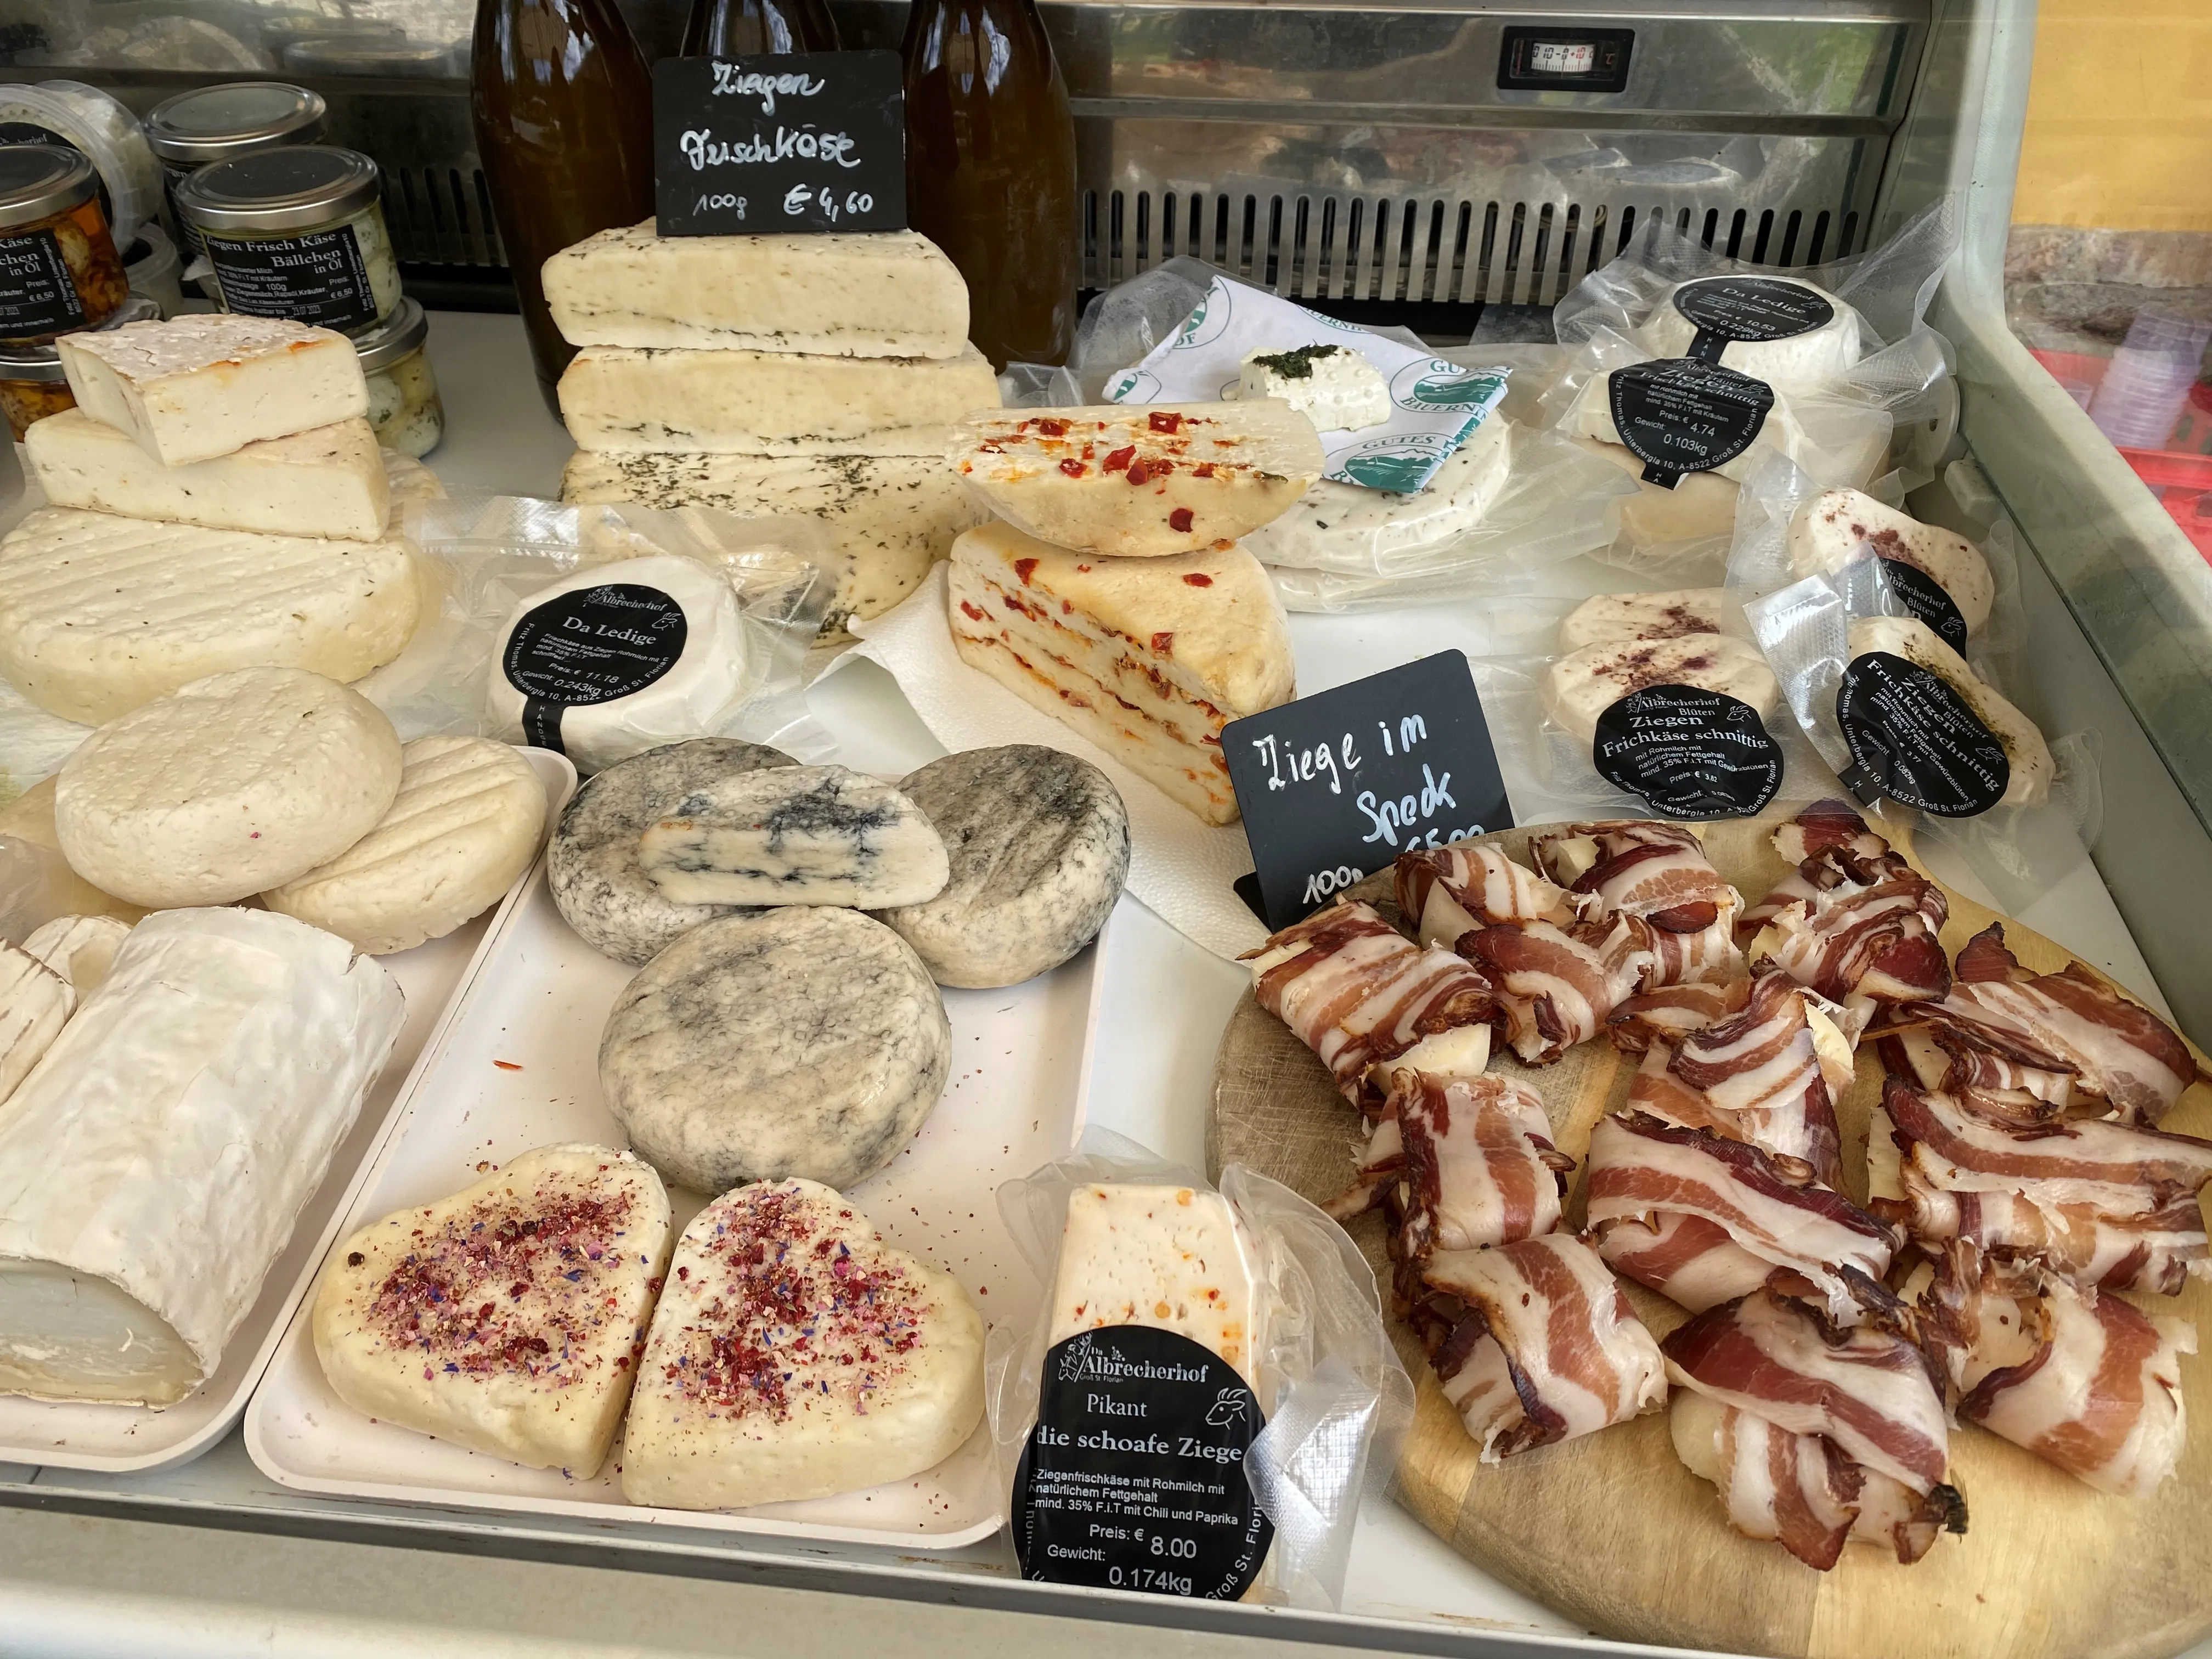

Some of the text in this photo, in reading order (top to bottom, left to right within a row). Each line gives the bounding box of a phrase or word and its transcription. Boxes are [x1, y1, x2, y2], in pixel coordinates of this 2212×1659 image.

[712, 61, 825, 116] Ziegen
[692, 183, 873, 222] 100g € 4,60
[245, 239, 295, 252] Frisch
[299, 233, 336, 247] Käse
[9, 261, 41, 275] in Öl
[270, 250, 341, 267] Bällchen
[314, 258, 343, 274] in Öl
[266, 283, 287, 291] 100g
[1722, 288, 1746, 297] Da
[1751, 295, 1807, 314] Ledige
[1746, 320, 1776, 331] 10.53
[1634, 416, 1708, 456] Gewicht: 0.103kg
[1659, 410, 1680, 421] Preis:
[1690, 422, 1716, 437] 4.74
[1362, 436, 1436, 449] GUTES
[1623, 428, 1661, 466] Unterbergla
[1679, 459, 1711, 470] A-8522
[1712, 447, 1734, 464] Groß
[1742, 408, 1758, 437] Florian
[1908, 597, 1936, 618] Blüten
[518, 623, 535, 640] Fritz
[562, 616, 657, 646] Da Ledige
[511, 641, 524, 670] Thomas,
[617, 650, 648, 661] Rohmilch
[645, 657, 669, 679] Florian
[513, 670, 546, 697] Unterbergla
[522, 670, 602, 697] Gewicht: 0.243kg
[549, 663, 573, 674] Preis:
[586, 672, 619, 684] 11.18
[605, 685, 630, 697] Groß
[1679, 708, 1716, 716] Blüten
[1881, 687, 1929, 741] mit Rohmilch mit
[1901, 678, 1955, 735] Ziegen
[1629, 715, 1704, 729] Ziegen
[1866, 659, 1999, 792] Frichkäse schnittig
[1875, 692, 1942, 760] natürlichem Fettgehalt
[1889, 714, 1903, 729] 35%
[1917, 745, 1929, 755] mit
[1943, 711, 1973, 738] Blüten
[1252, 714, 1426, 794] Ziege im
[1602, 729, 1769, 758] Frichkäse schnittig
[1649, 746, 1687, 755] Rohmilch
[1906, 751, 1922, 763] 3.77
[1638, 752, 1726, 770] natürlichem Fettgehalt
[1641, 767, 1662, 778] mind.
[1663, 758, 1682, 768] 35%
[1845, 724, 1978, 811] Unterbergla 10, A-8522 Groß Florian
[1862, 730, 1916, 785] Gewicht: 0.082kg
[1705, 774, 1718, 783] 3.82
[1748, 794, 1767, 812] Groß
[1767, 760, 1776, 785] Florian
[1356, 764, 1457, 847] Speck
[1083, 1356, 1209, 1383] Albrecherhof
[1087, 1393, 1148, 1418] Pikant
[1037, 1425, 1242, 1464] die schoafe Ziege
[1036, 1469, 1224, 1495] Ziegenfrischkäse mit Rohmilch mit
[1036, 1484, 1158, 1503] natürlichem Fettgehalt
[1035, 1498, 1064, 1509] mind.
[1068, 1500, 1093, 1512] 35%
[1124, 1504, 1141, 1516] mit
[1143, 1506, 1169, 1519] Chili
[1171, 1509, 1192, 1521] und
[1195, 1510, 1239, 1526] Paprika
[1089, 1524, 1197, 1559] Preis: € 8.00
[1047, 1544, 1192, 1596] Gewicht: 0.174kg
[1235, 1551, 1252, 1572] St.
